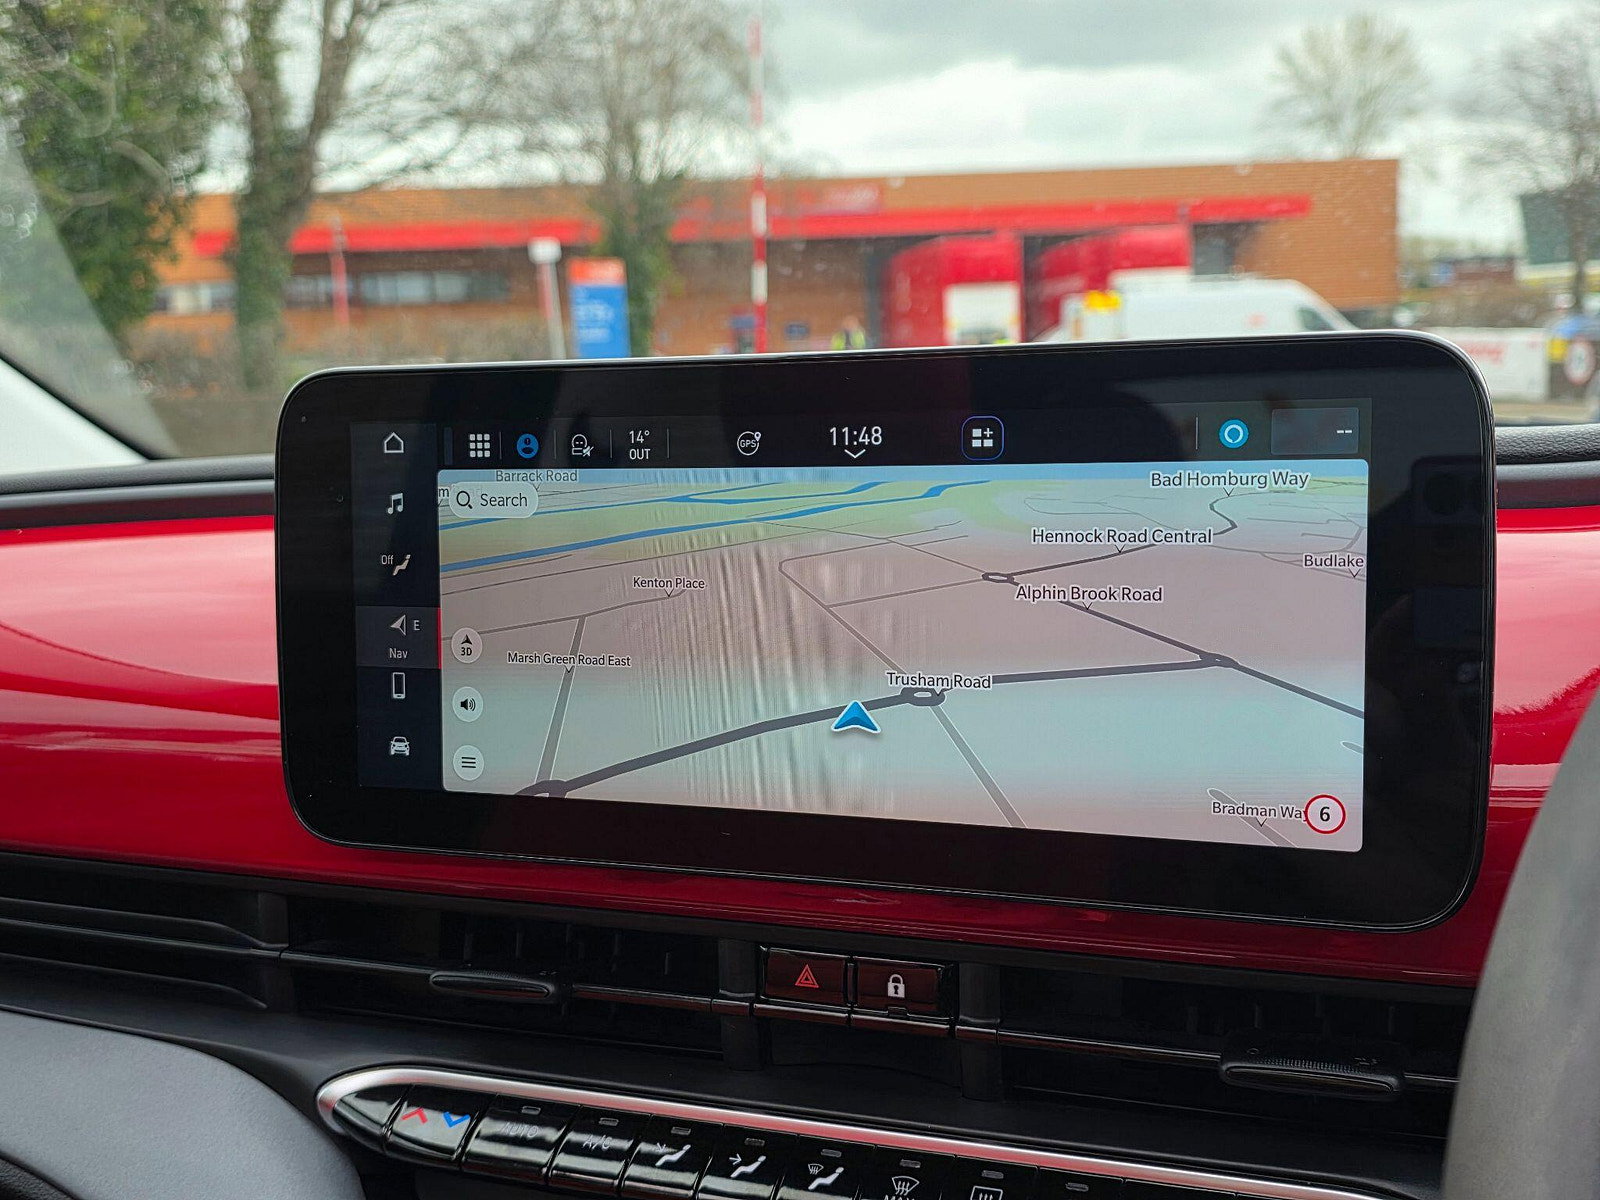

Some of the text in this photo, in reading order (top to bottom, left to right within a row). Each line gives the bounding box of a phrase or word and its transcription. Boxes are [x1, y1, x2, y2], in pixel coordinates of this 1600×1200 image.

[629, 430, 650, 444] 14°
[829, 426, 883, 446] 11:48
[740, 439, 757, 448] GPS
[629, 448, 651, 460] OUT
[495, 469, 578, 482] Barrack Road
[1151, 471, 1309, 489] Bad Homburg Way
[480, 492, 528, 508] Search
[1032, 529, 1212, 543] Hennock Road Central
[381, 554, 394, 565] Off
[1304, 553, 1365, 568] Budlake
[633, 577, 706, 589] Kenton Place
[1016, 585, 1163, 602] Alphin Brook Road
[413, 619, 421, 631] E
[389, 647, 409, 659] Nav
[460, 646, 473, 656] 3D
[507, 652, 631, 667] Marsh Green Road East
[887, 672, 991, 689] Trusham Road
[1212, 802, 1277, 817] Bradman
[1319, 806, 1331, 822] 6
[582, 1134, 613, 1152] A/C
